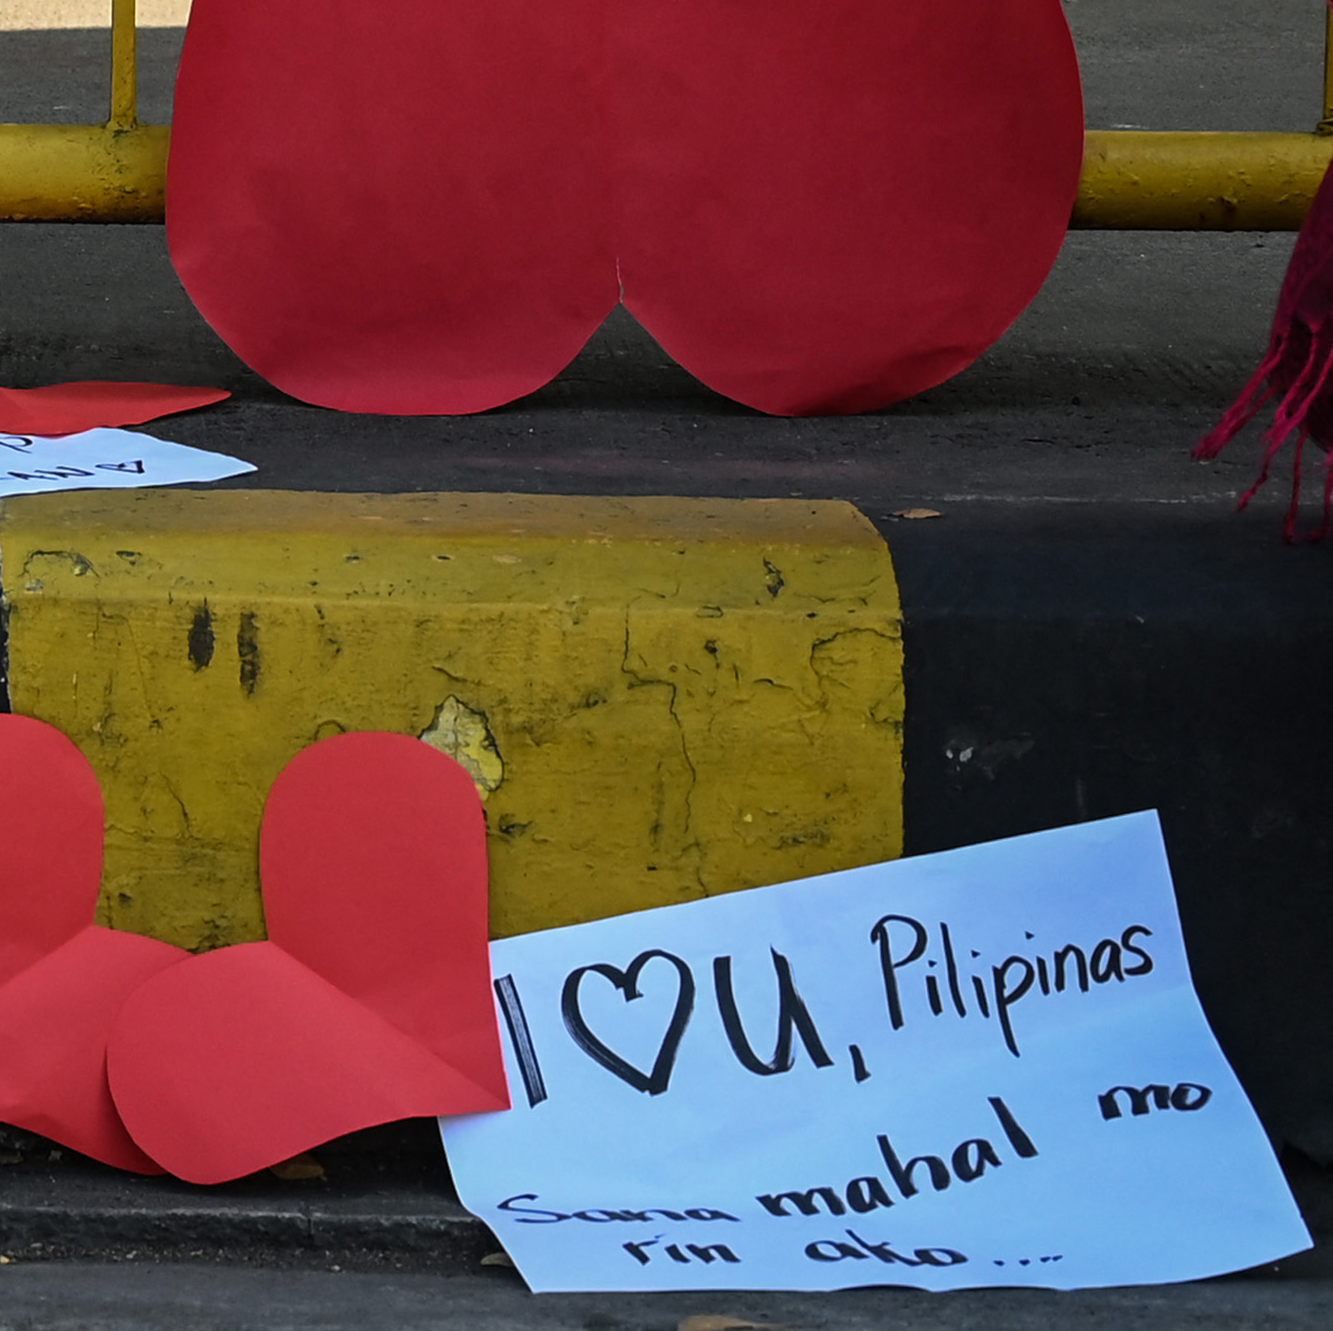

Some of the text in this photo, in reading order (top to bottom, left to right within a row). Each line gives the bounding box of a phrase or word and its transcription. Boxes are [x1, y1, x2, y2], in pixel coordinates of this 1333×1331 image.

[871, 913, 1155, 1058] Pilipinas
[497, 1080, 1214, 1228] Sana mahal mo
[620, 1233, 742, 1267] rin
